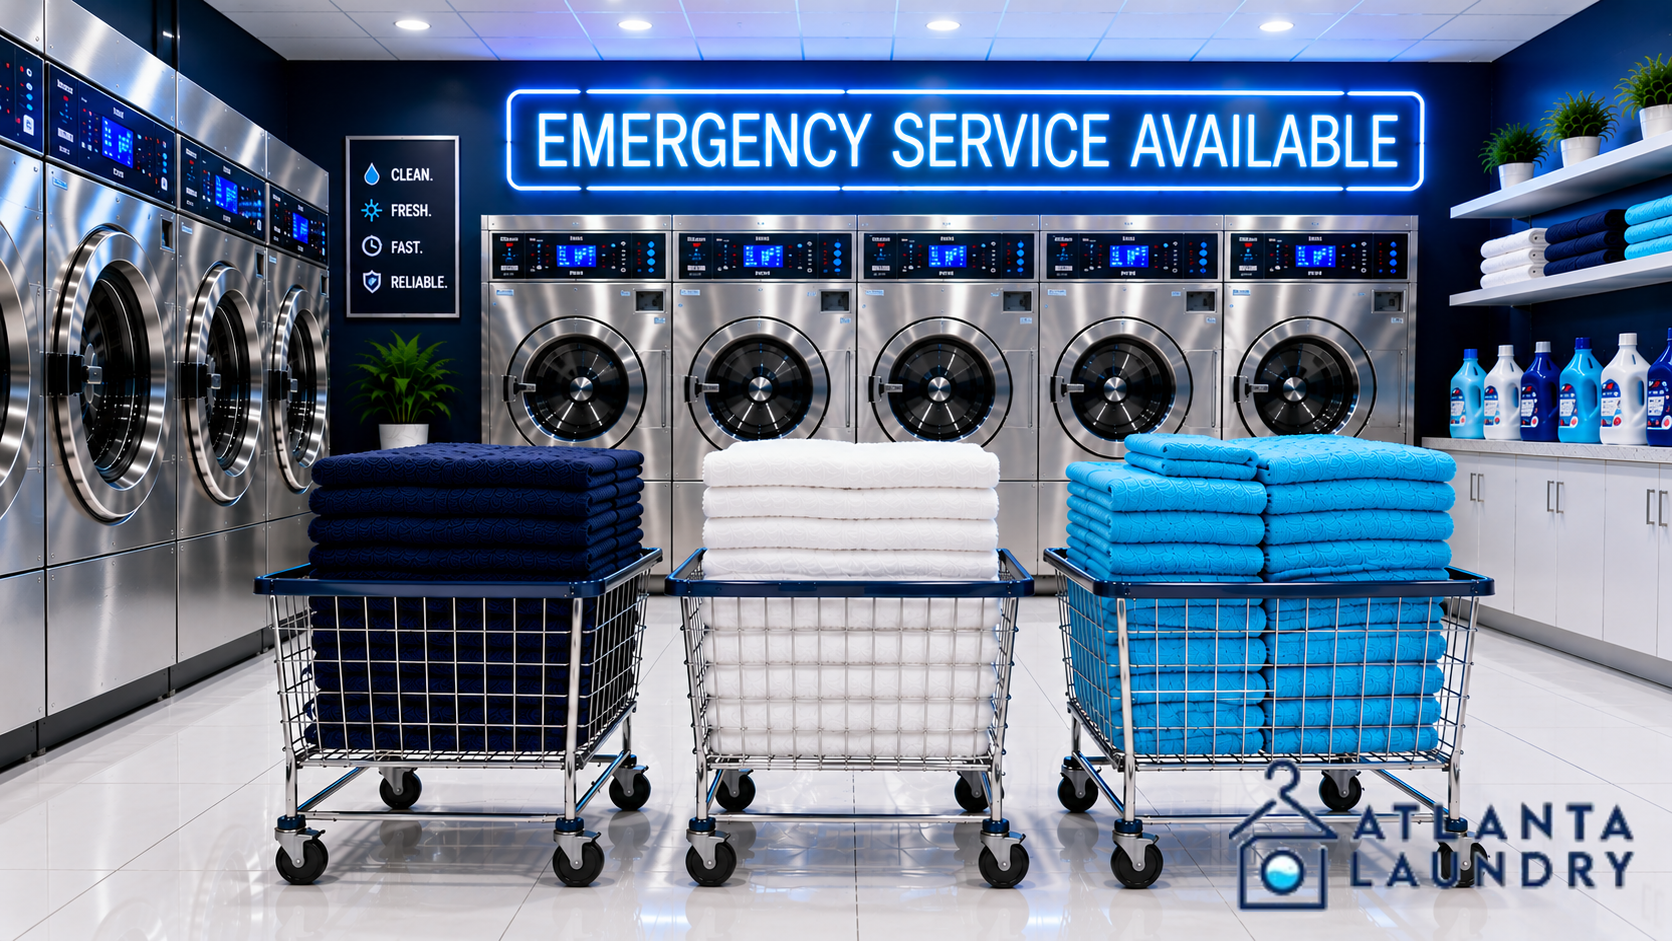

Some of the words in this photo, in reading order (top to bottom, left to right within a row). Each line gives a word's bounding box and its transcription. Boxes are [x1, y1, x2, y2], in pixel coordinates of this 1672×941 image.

[537, 111, 873, 169] EMERGENCY
[891, 111, 1111, 169] SERVICE
[1130, 112, 1400, 169] AVAILABLE
[391, 167, 434, 182] CLEAN.
[391, 203, 432, 217] FRESH.
[391, 240, 423, 254] FAST.
[391, 275, 448, 289] RELIABLE.
